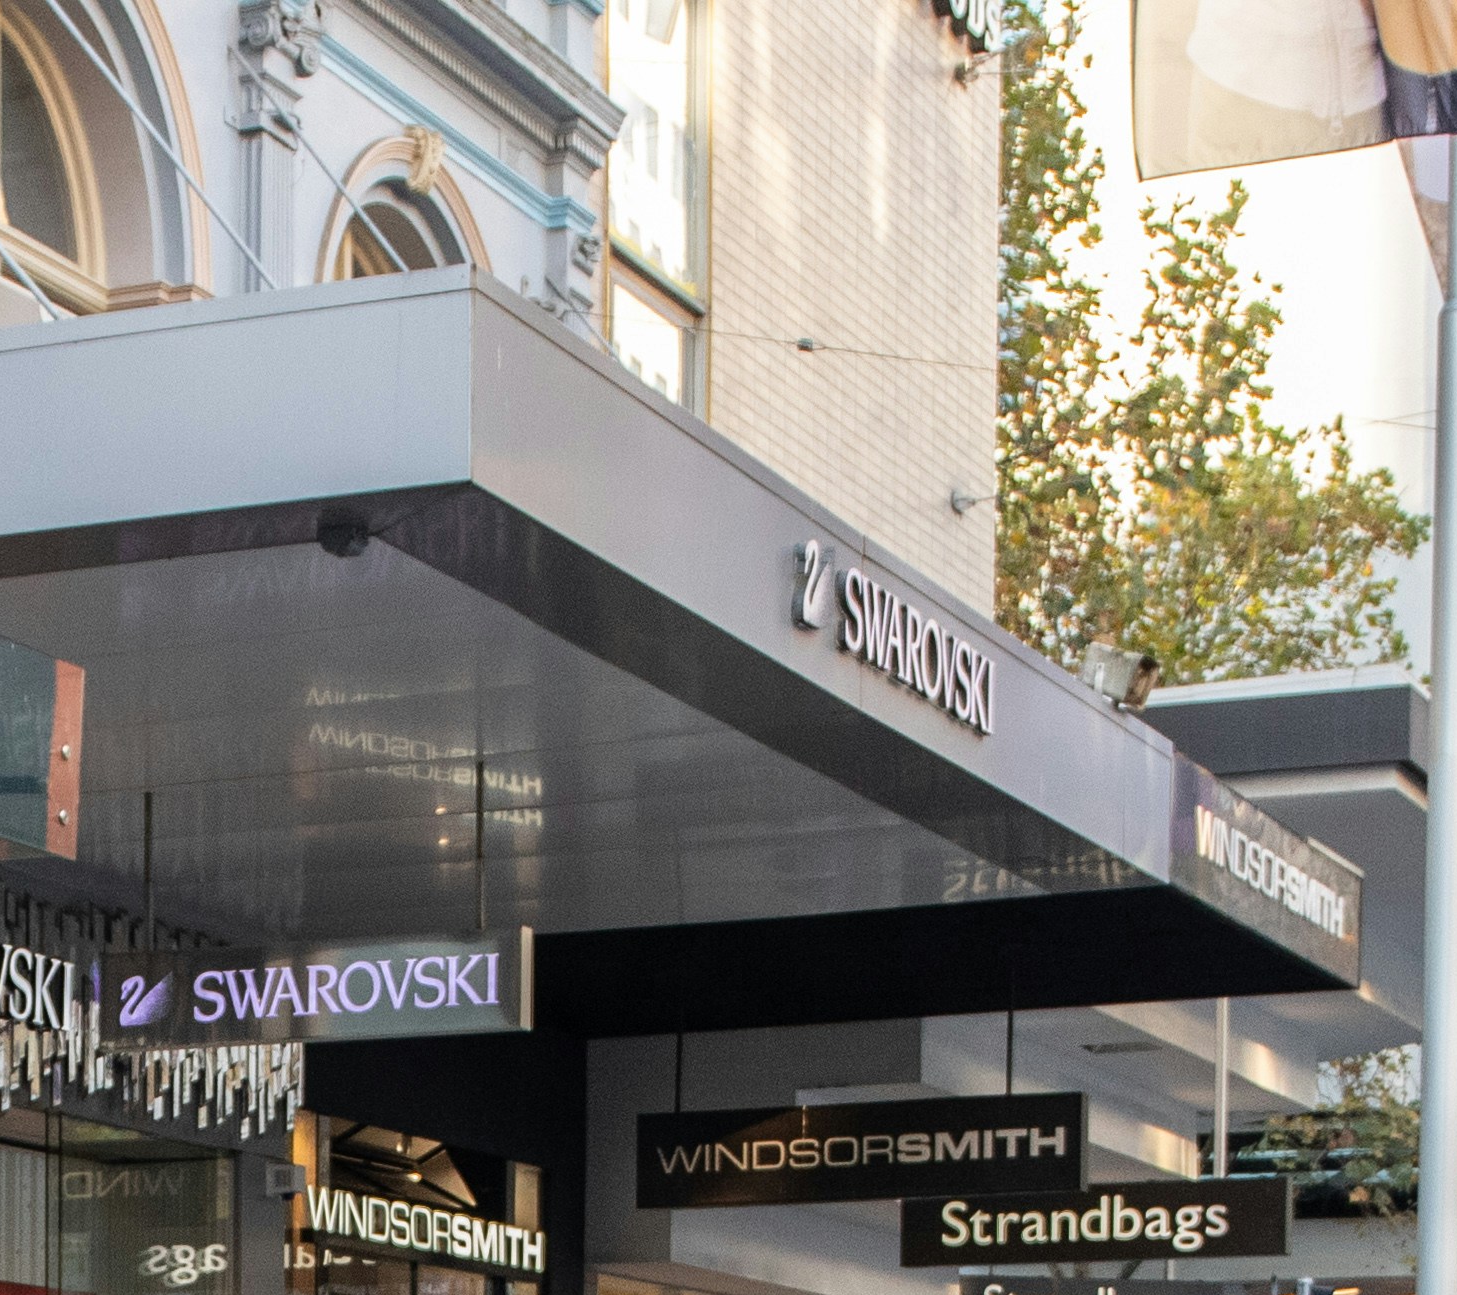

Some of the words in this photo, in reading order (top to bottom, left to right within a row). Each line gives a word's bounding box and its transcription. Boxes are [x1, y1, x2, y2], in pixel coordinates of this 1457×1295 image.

[836, 566, 996, 736] SWAROVSKI
[192, 952, 501, 1024] SWAROVSKI
[656, 1125, 1067, 1175] WINDSORSMITH
[305, 1184, 546, 1273] WINDSORSMITH
[940, 1195, 1229, 1253] Strandbags
